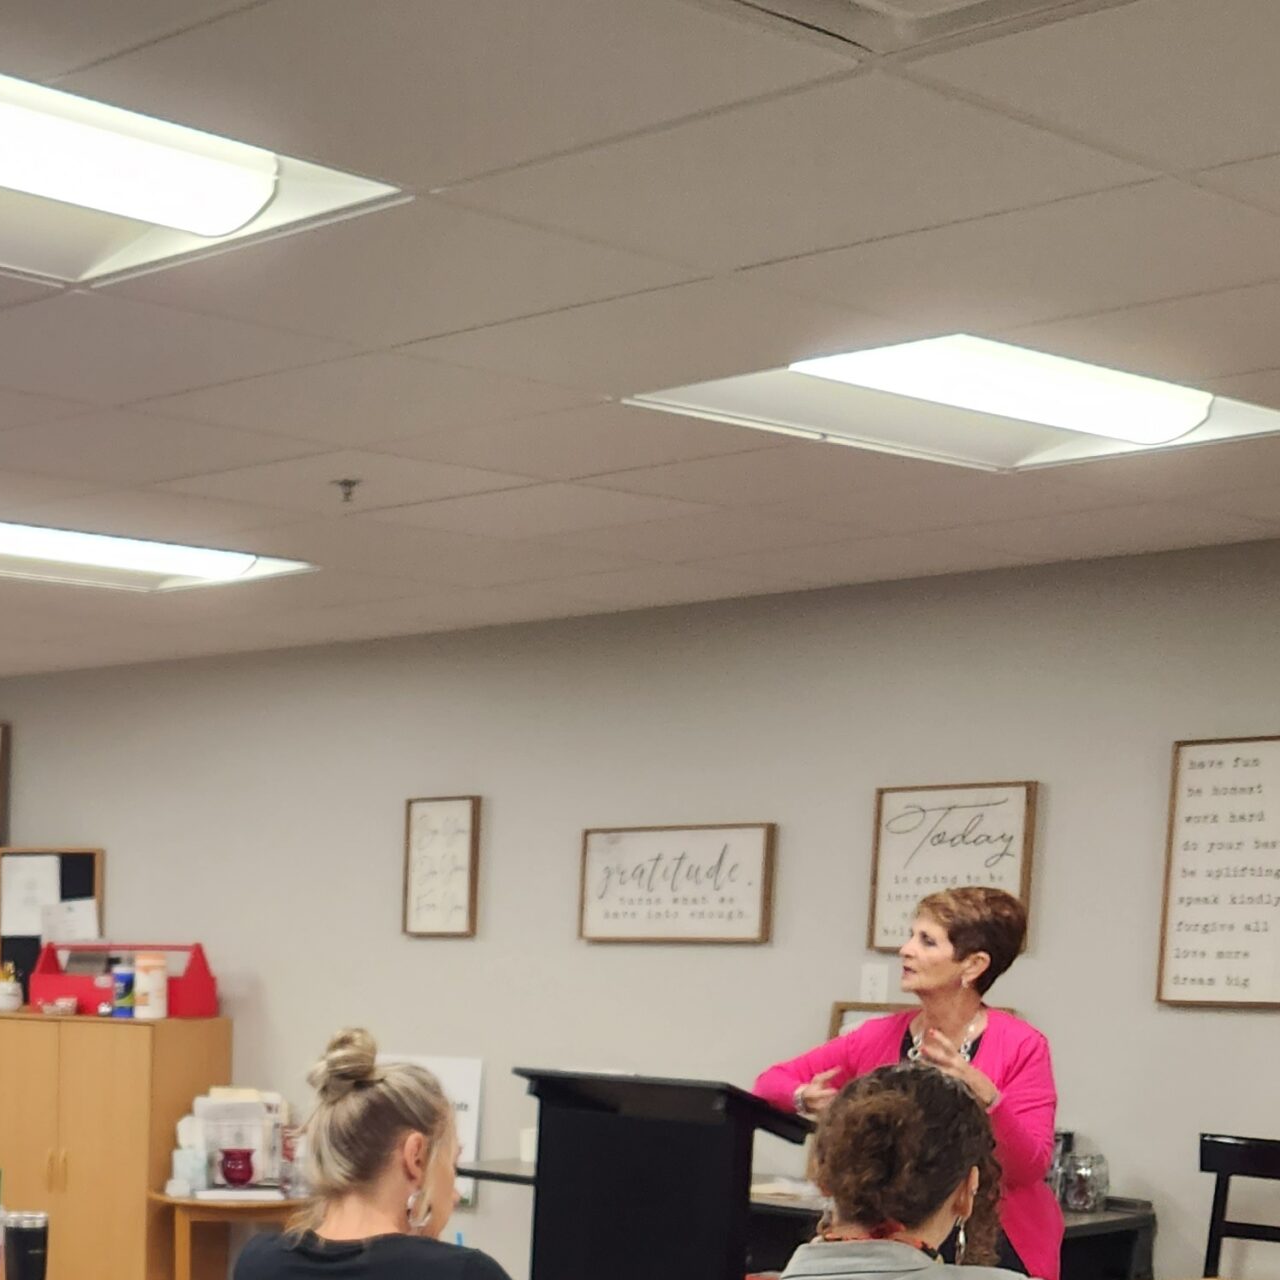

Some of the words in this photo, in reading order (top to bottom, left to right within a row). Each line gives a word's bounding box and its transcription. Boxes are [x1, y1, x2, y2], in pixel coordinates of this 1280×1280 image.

[1187, 758, 1224, 770] have
[1232, 756, 1260, 769] fun
[1187, 786, 1203, 797] be
[1212, 783, 1263, 796] honest
[1184, 812, 1219, 824] work
[1229, 809, 1265, 823] hard
[885, 798, 1015, 869] Today
[1182, 840, 1198, 852] do
[1207, 841, 1244, 853] your
[1253, 838, 1280, 850] bes
[915, 873, 958, 886] going
[1181, 867, 1197, 878] be
[671, 895, 710, 905] what
[1178, 894, 1219, 908] speak
[603, 909, 638, 920] have
[646, 909, 680, 920] into
[1176, 921, 1235, 934] forgive
[1244, 920, 1268, 932] all
[1174, 947, 1207, 959] love
[1216, 950, 1251, 960] more
[1172, 974, 1216, 986] dream
[1225, 975, 1251, 989] big
